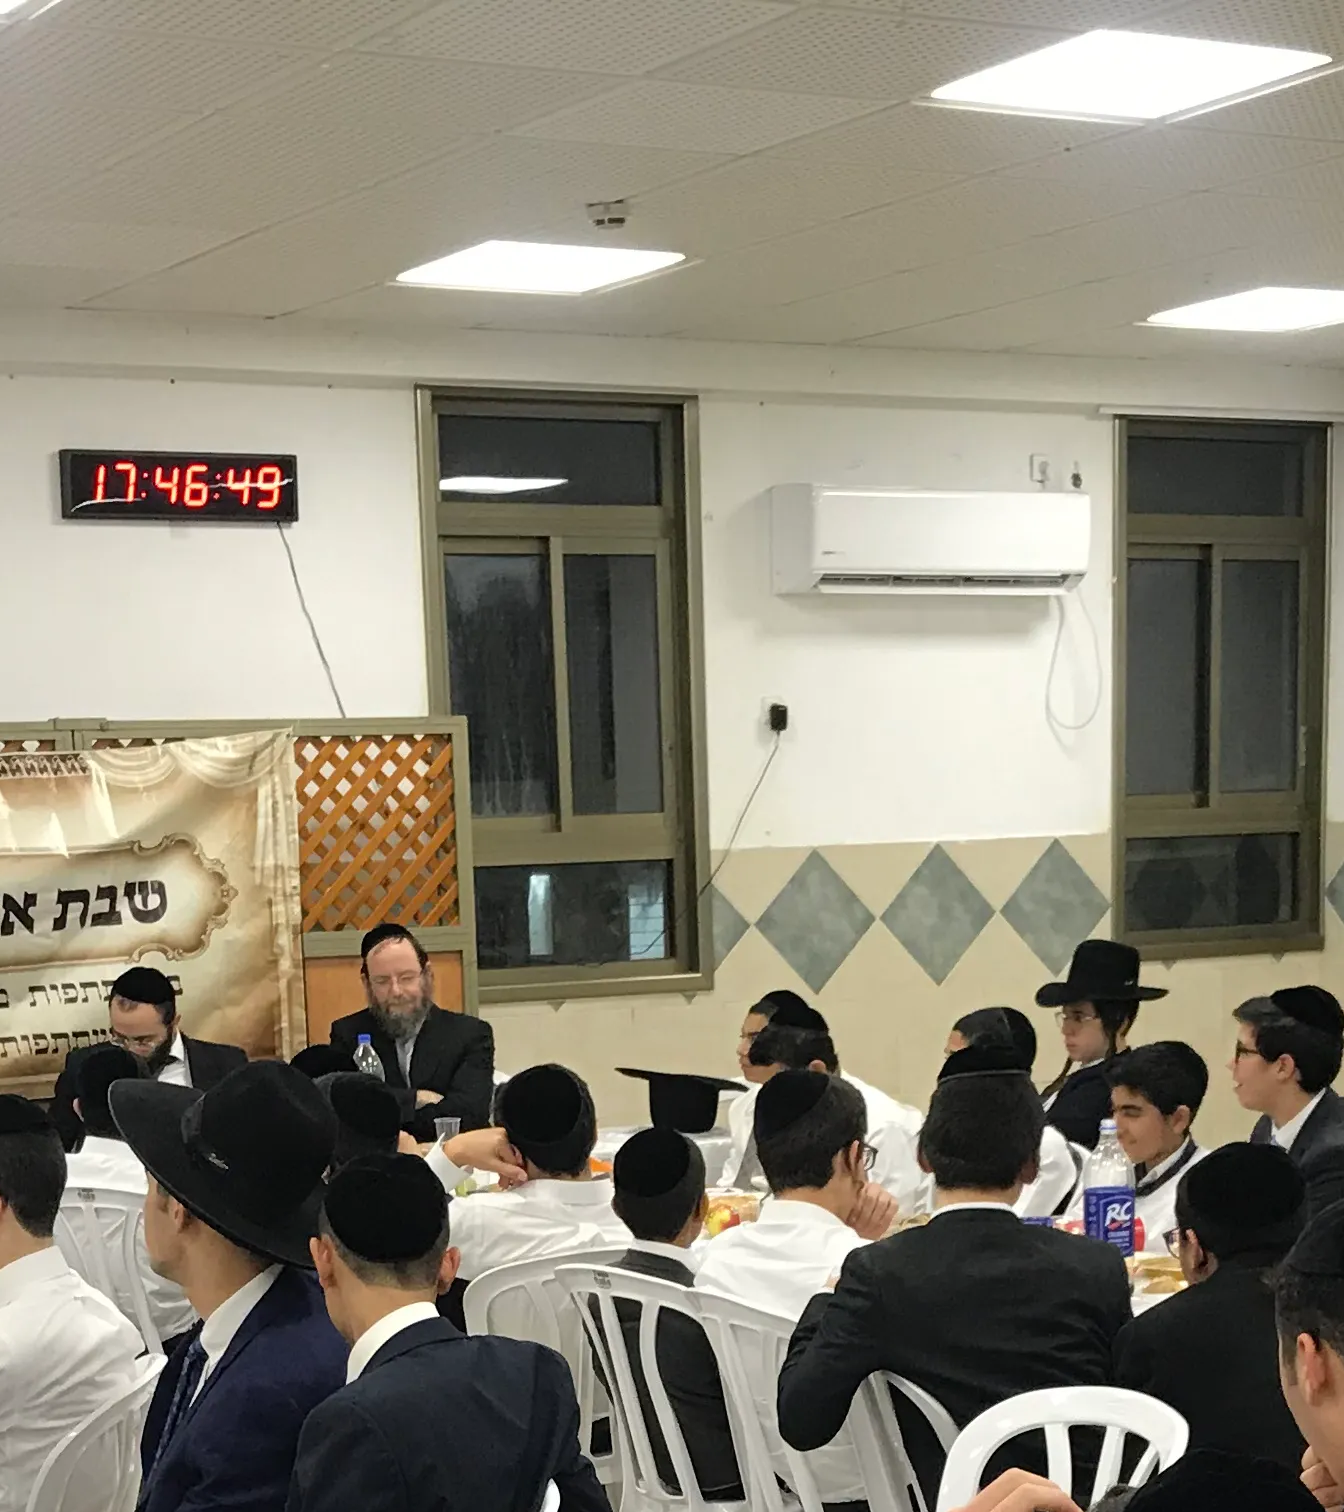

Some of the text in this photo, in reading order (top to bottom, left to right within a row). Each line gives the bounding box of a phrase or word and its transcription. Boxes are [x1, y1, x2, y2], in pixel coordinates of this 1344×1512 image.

[94, 460, 282, 508] 17:46:49
[52, 880, 168, 931] שבת
[1105, 1201, 1132, 1227] RC
